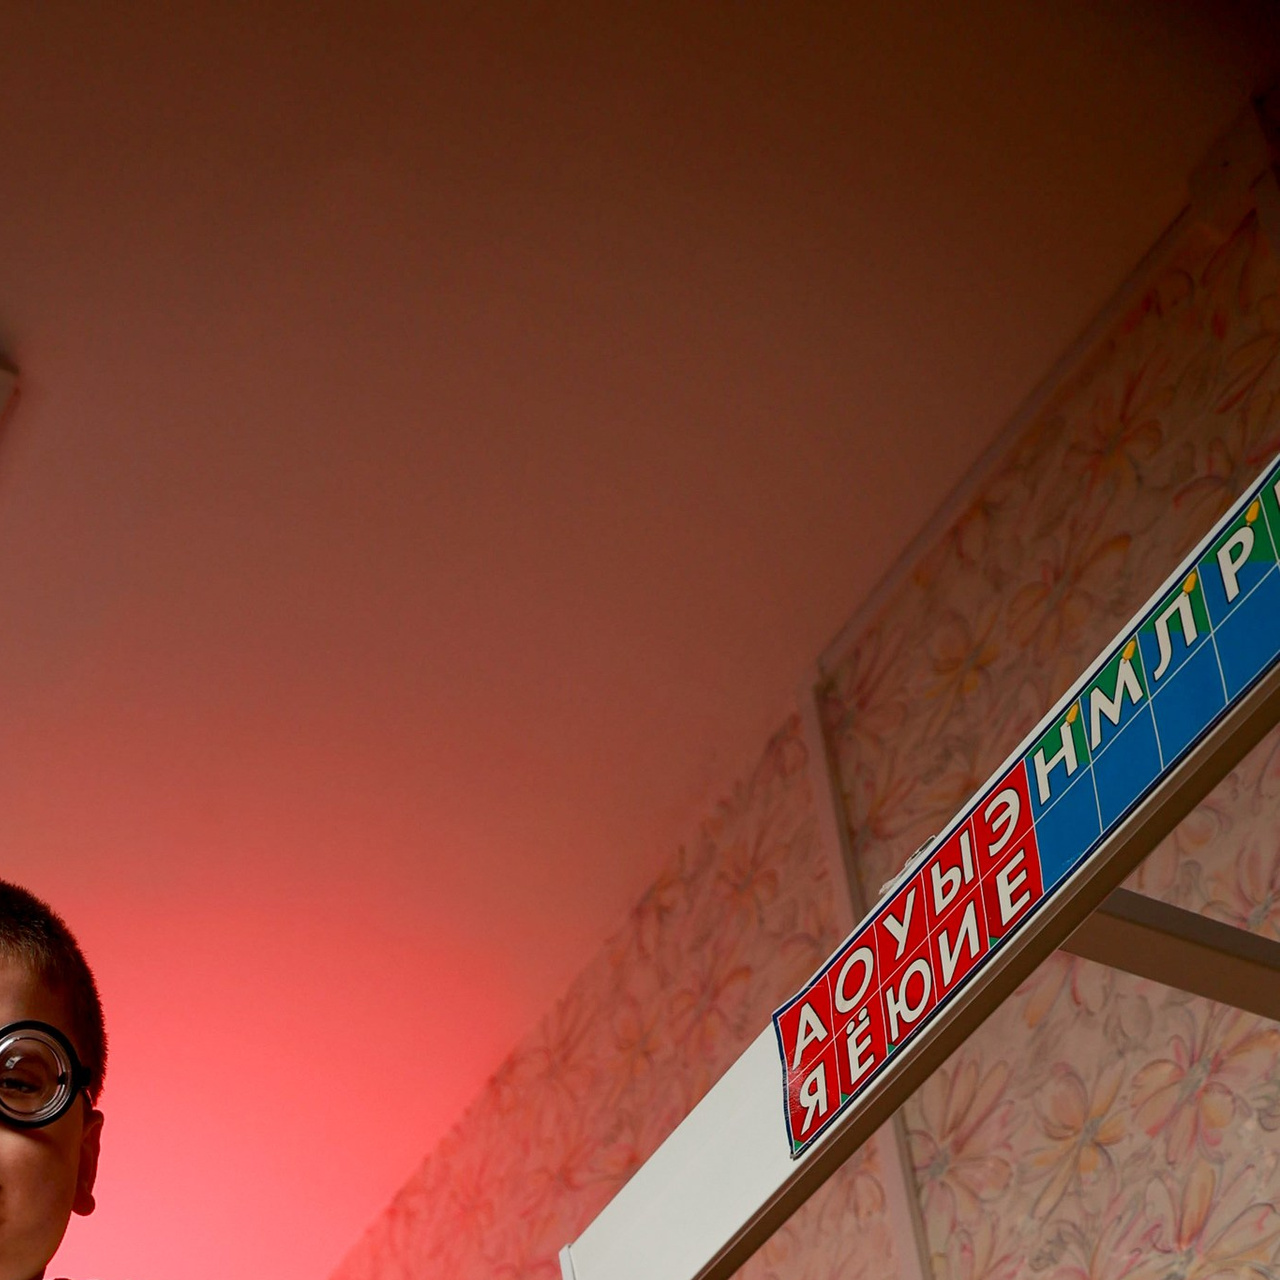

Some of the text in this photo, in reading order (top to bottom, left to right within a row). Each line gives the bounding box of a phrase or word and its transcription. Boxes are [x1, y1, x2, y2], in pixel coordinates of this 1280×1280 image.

[792, 525, 1255, 1071] А О У Ы Э Н М Л Р
[799, 847, 1031, 1136] Я Ё Ю И Е
